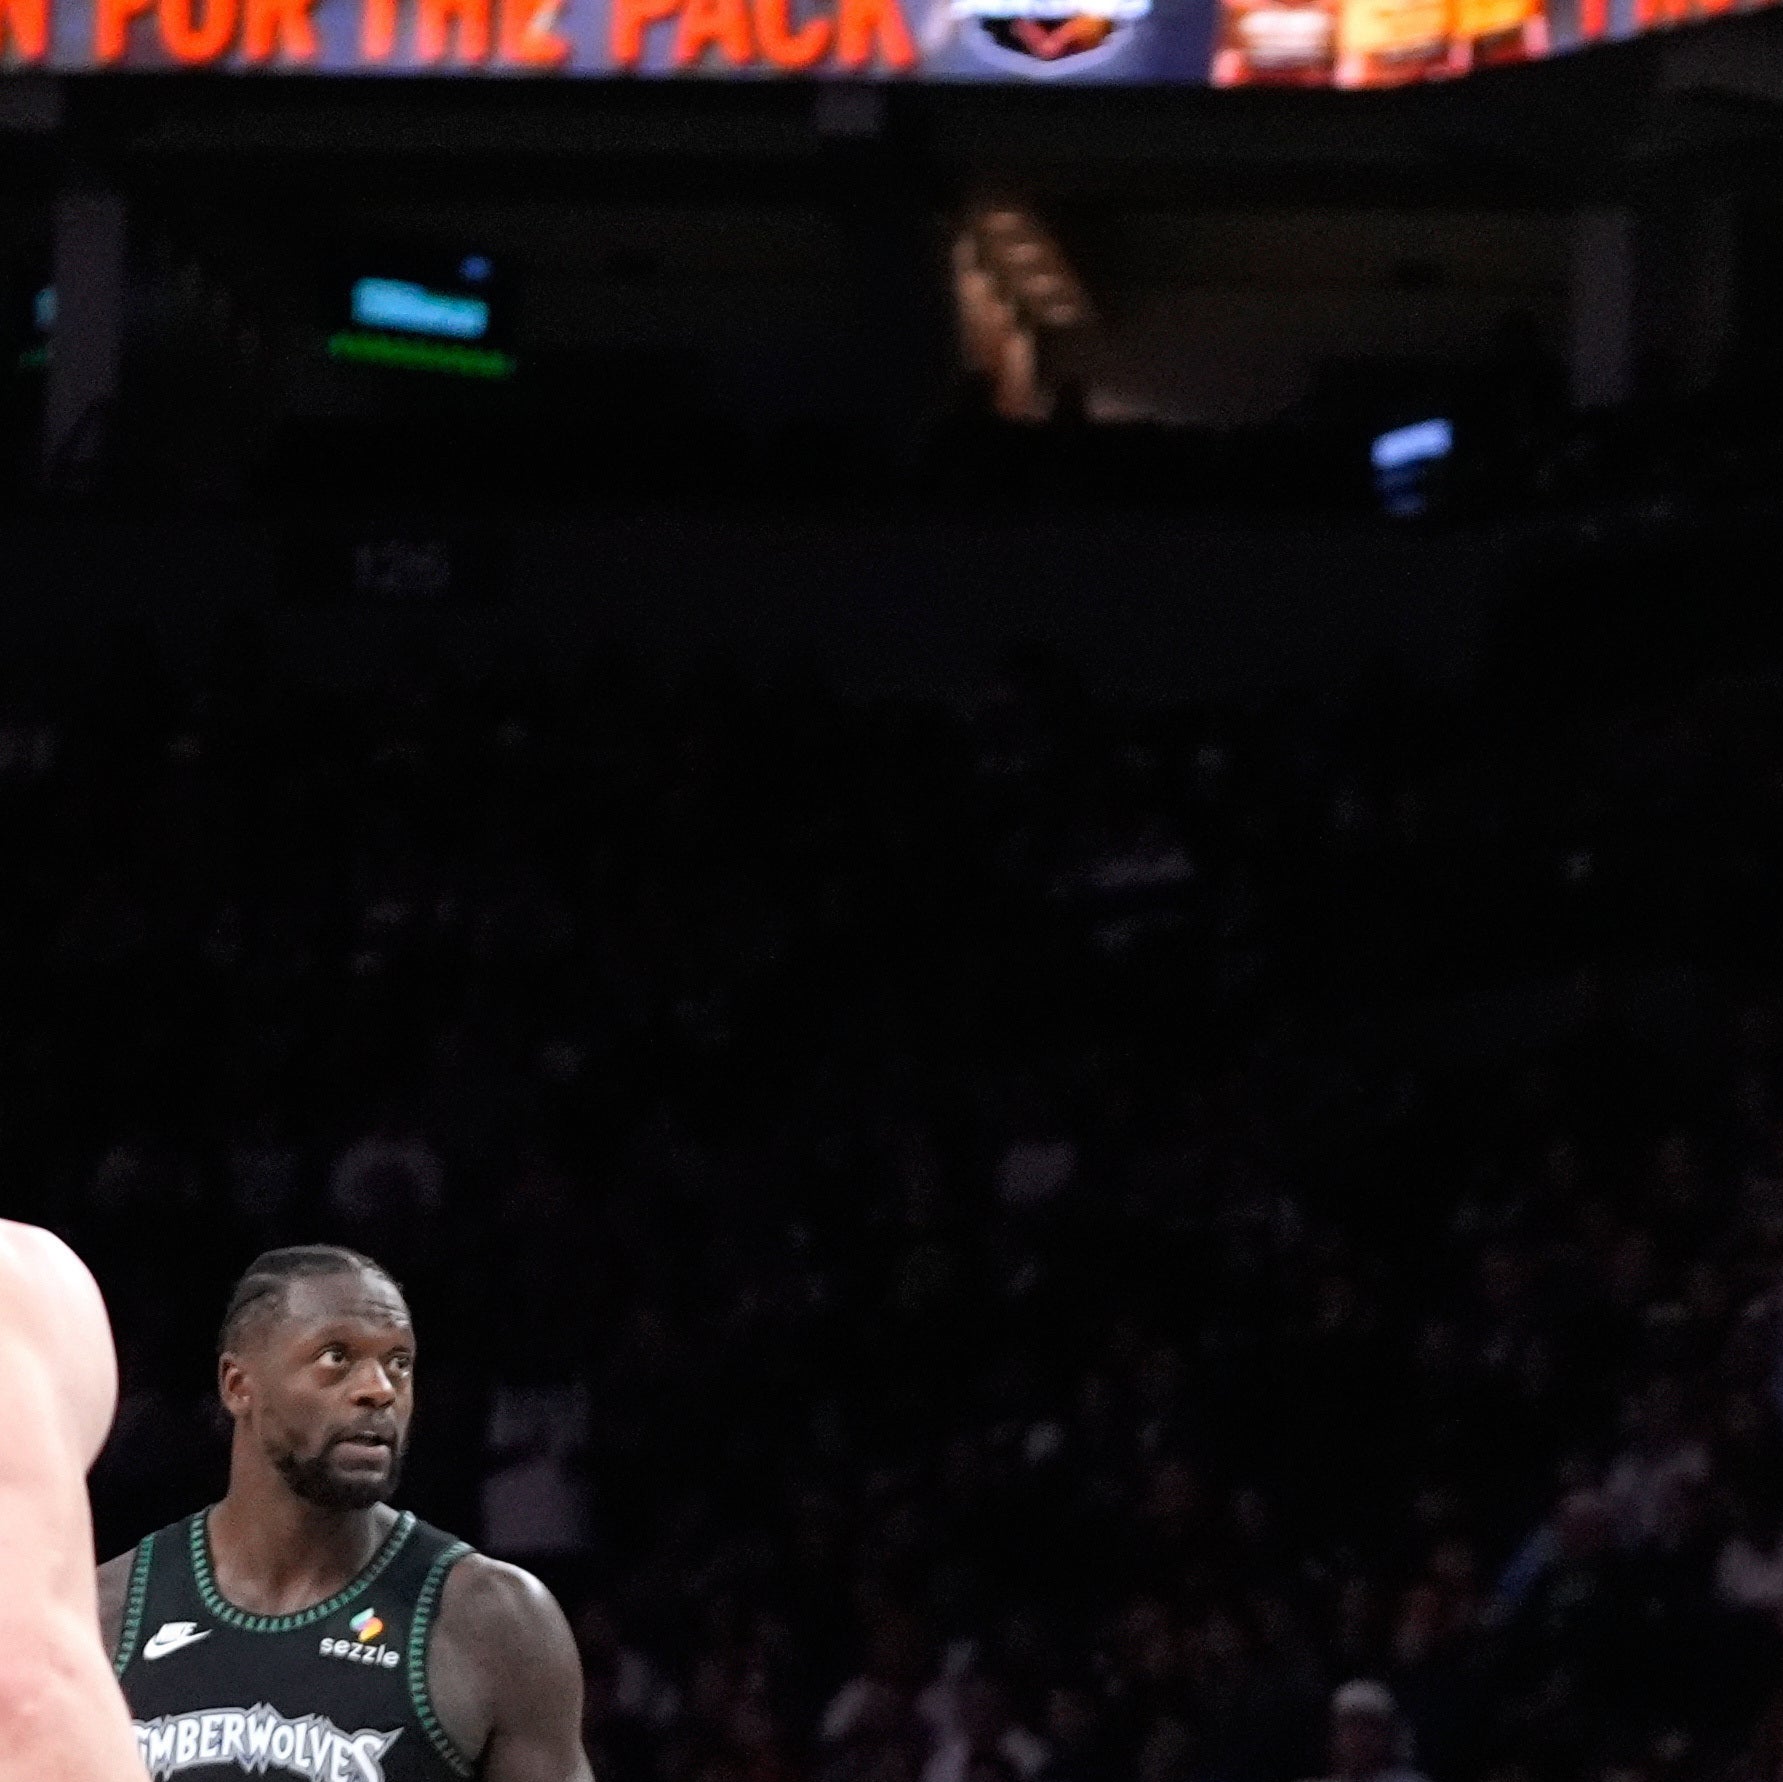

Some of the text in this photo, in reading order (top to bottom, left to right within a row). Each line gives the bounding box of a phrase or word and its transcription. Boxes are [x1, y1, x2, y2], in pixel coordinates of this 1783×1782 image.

[92, 0, 318, 62] FOR
[360, 0, 570, 63] THE
[608, 0, 916, 66] PACK
[319, 1635, 400, 1668] sezzle
